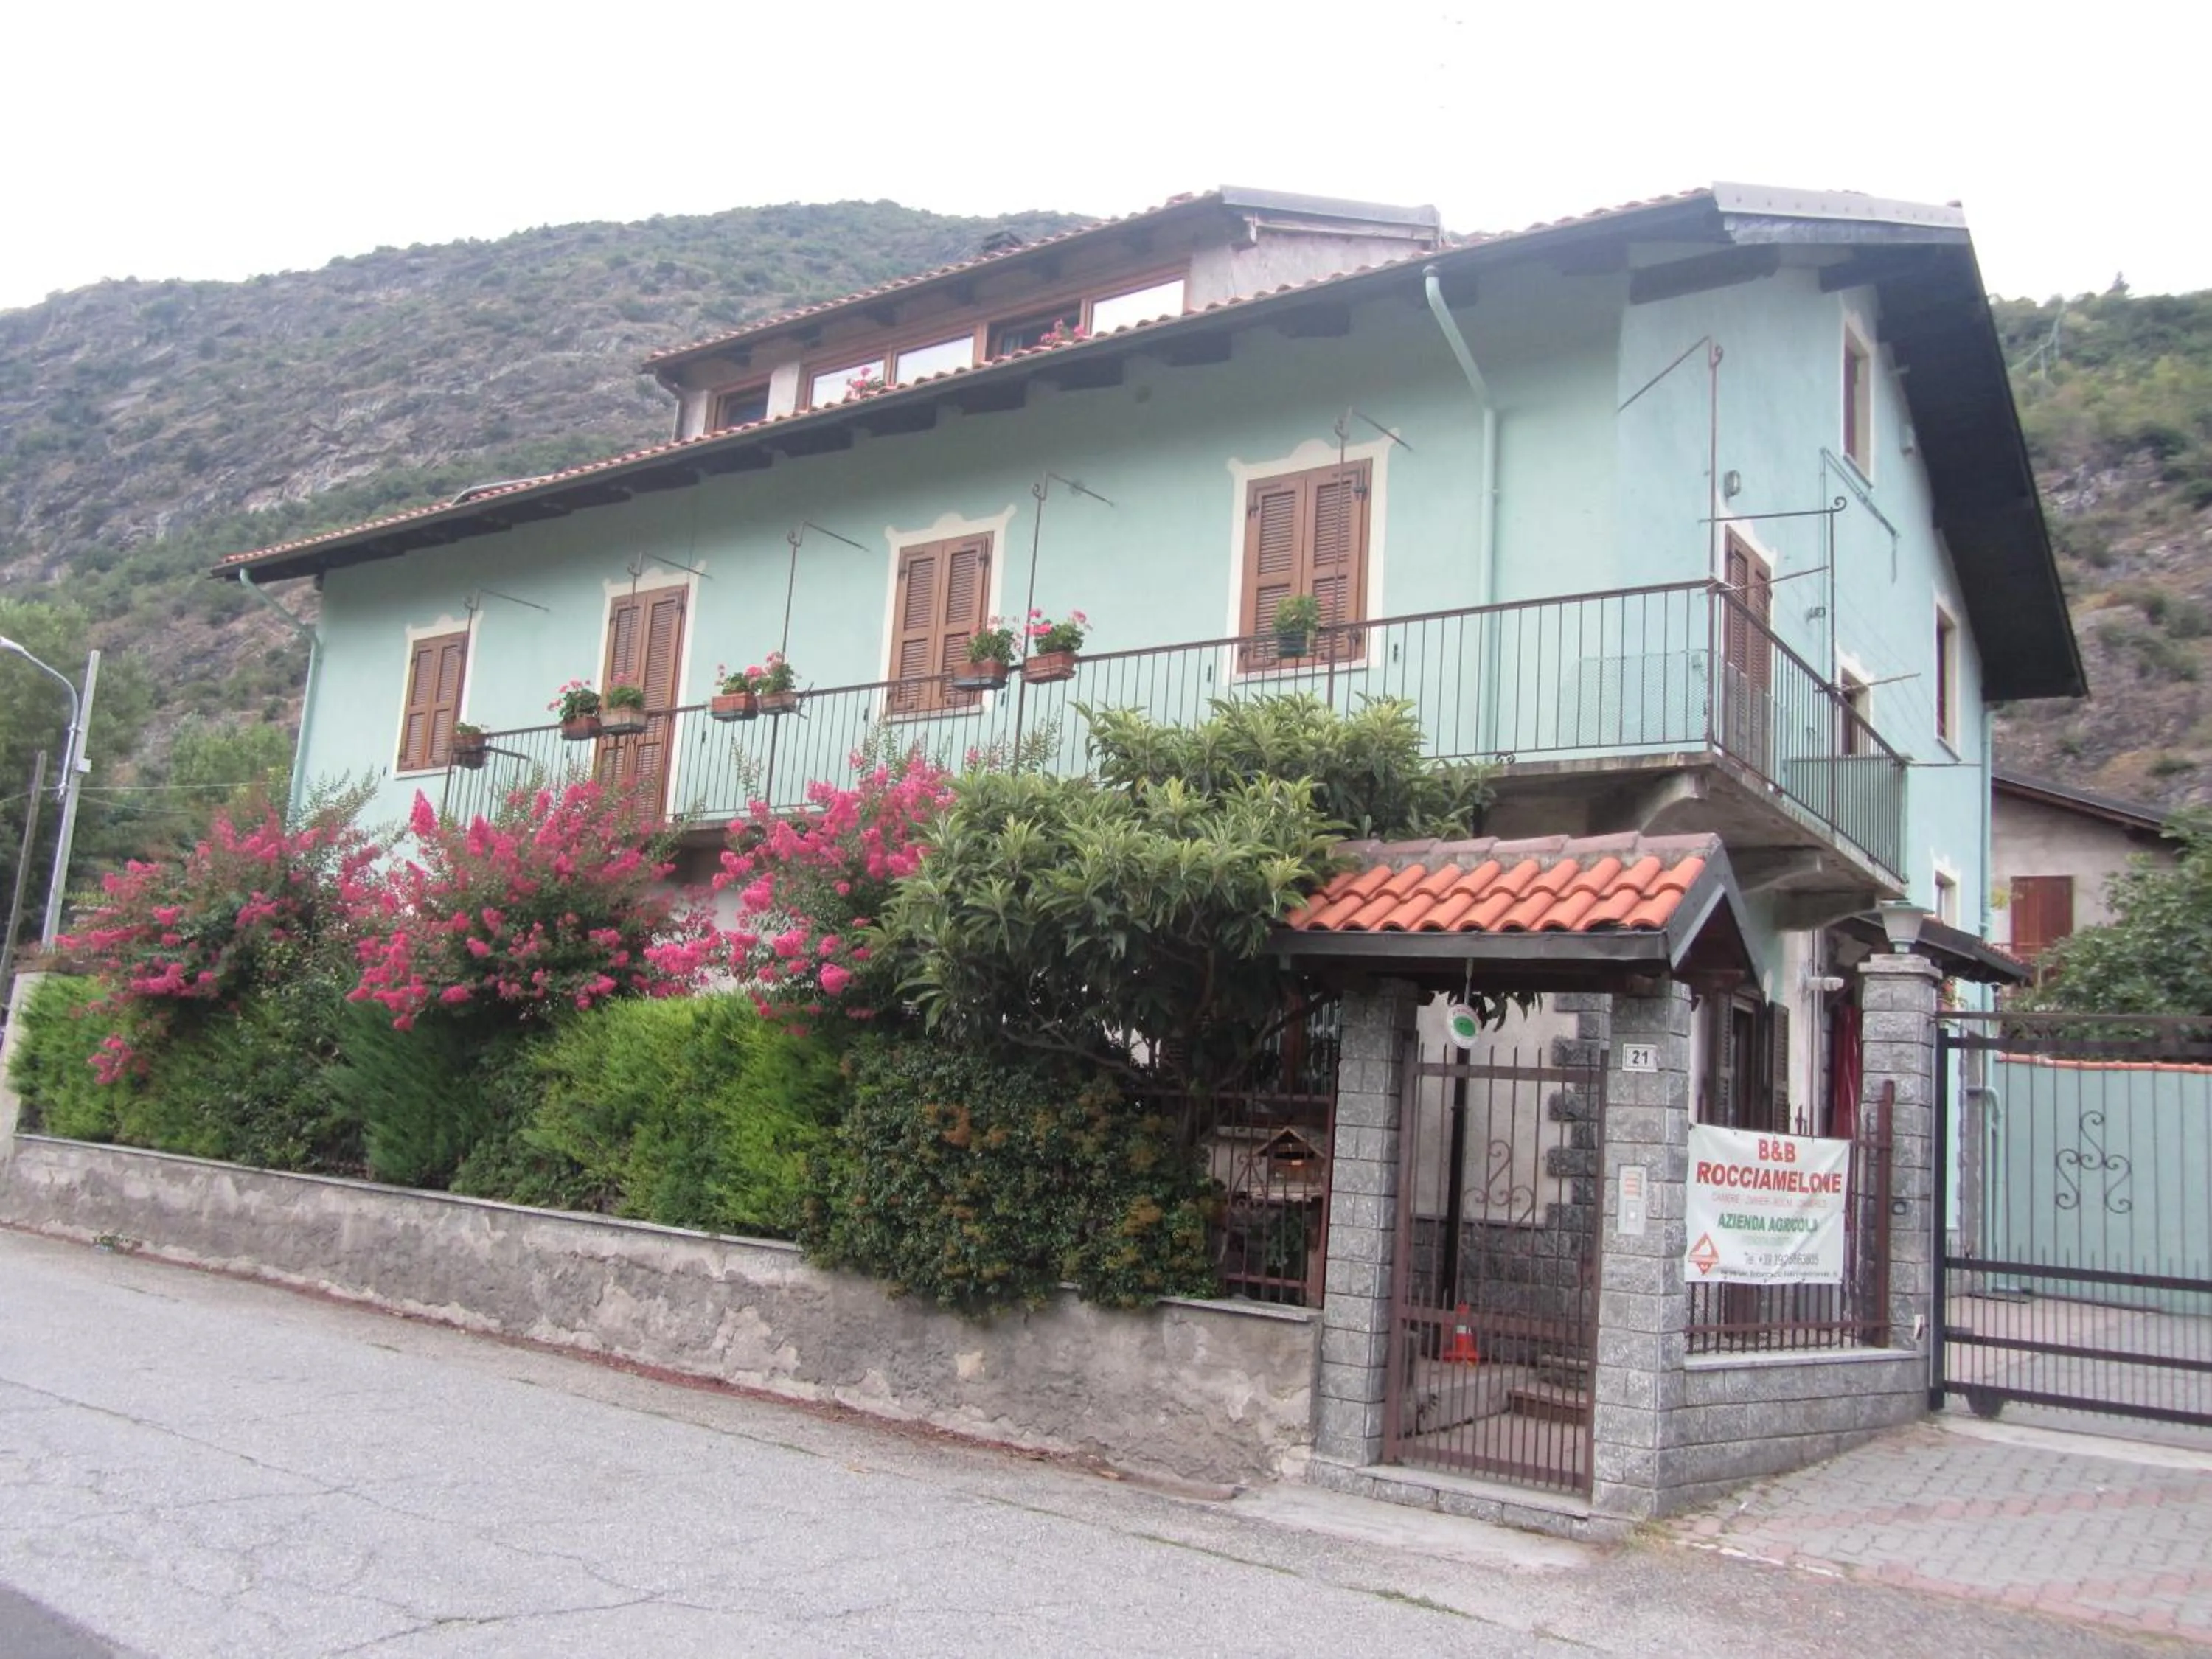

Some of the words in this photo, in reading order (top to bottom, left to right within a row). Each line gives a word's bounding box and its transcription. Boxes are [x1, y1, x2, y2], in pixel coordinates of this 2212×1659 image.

[1632, 1050, 1649, 1065] 21
[1758, 1138, 1796, 1163] B&B
[1696, 1161, 1842, 1193] ROCCIAMELONE
[1717, 1213, 1765, 1232] AZIENDA
[1768, 1217, 1818, 1234] AGRICOLA
